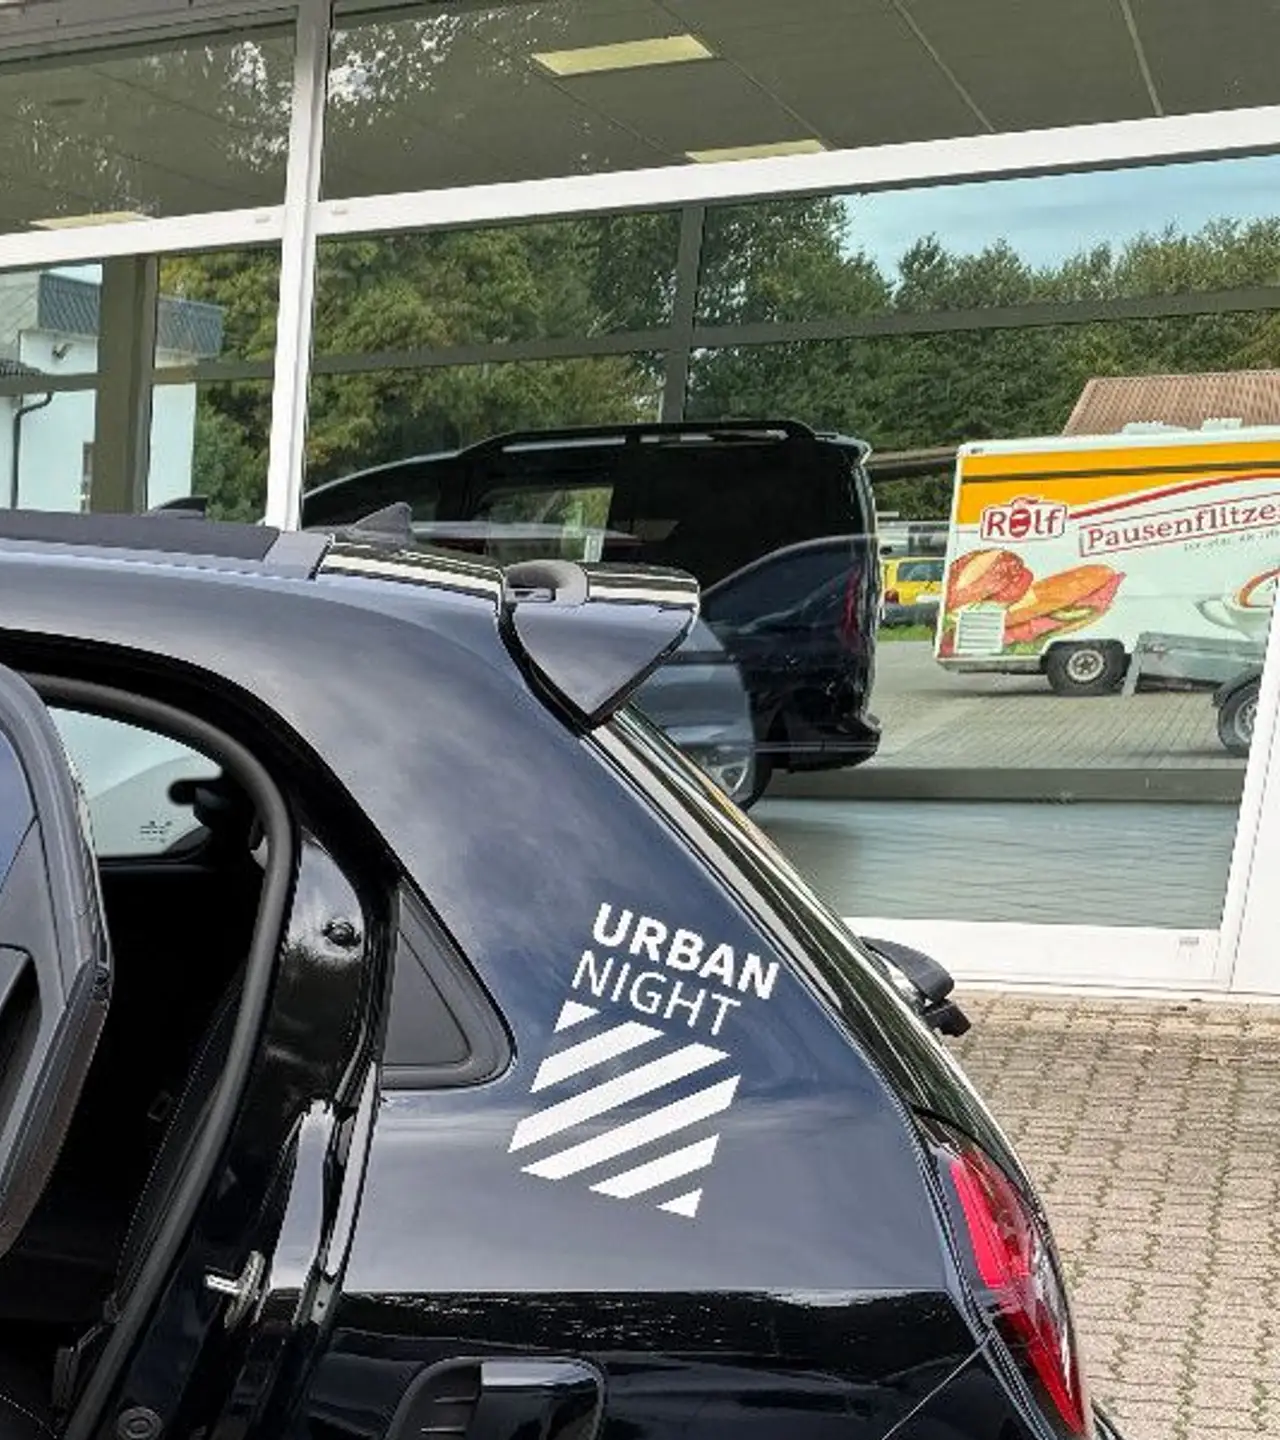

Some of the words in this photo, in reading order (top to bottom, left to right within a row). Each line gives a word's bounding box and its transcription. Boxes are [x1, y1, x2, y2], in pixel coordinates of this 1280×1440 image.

[986, 507, 1063, 538] Rolf
[1088, 502, 1280, 550] Pausenflitze
[592, 902, 780, 1000] URBAN
[571, 950, 741, 1036] NIGHT
